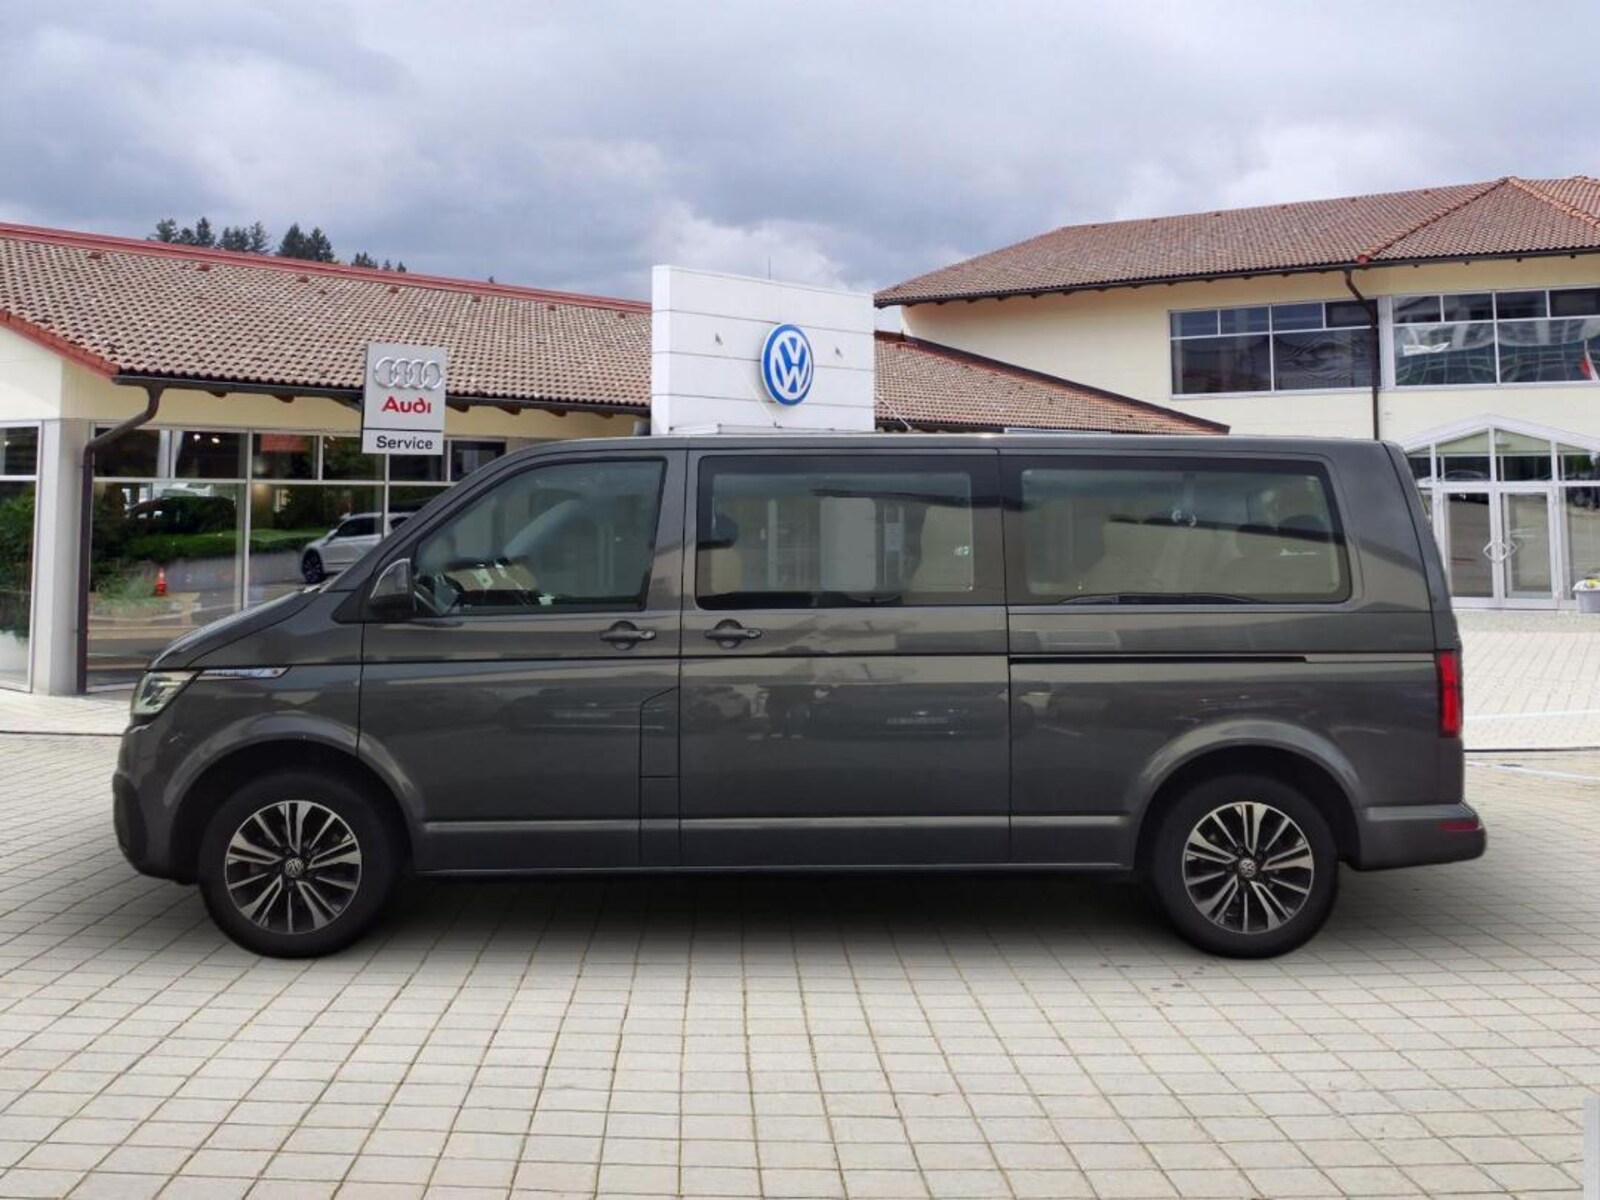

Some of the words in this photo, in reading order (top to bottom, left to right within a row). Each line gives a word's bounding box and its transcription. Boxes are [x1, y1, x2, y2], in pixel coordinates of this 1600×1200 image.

[766, 327, 813, 402] VW
[381, 395, 432, 414] Audi
[376, 435, 433, 450] Service
